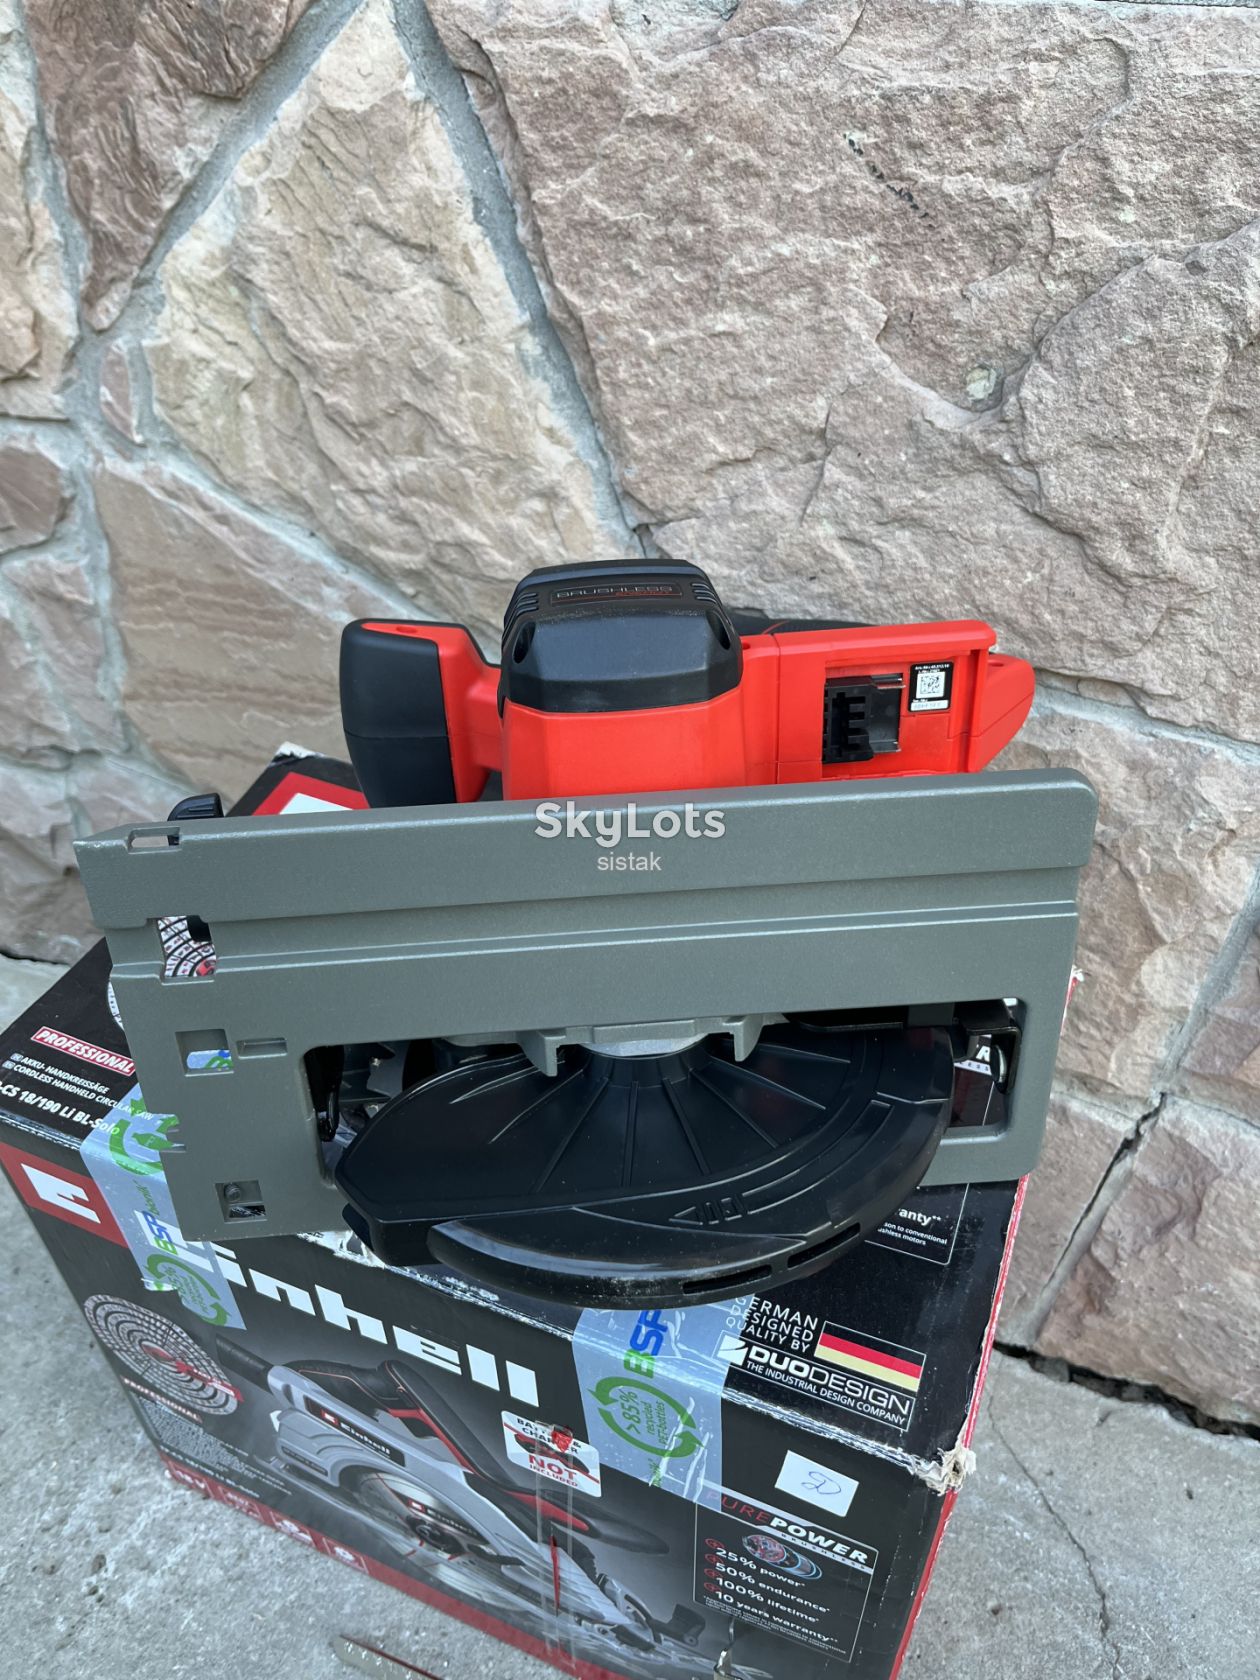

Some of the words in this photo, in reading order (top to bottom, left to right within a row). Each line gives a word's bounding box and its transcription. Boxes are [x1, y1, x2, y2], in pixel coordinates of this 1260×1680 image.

[36, 1030, 135, 1073] PROFESSIONAL
[13, 1064, 54, 1083] CORDLESS
[51, 1079, 96, 1100] HANDHELD
[21, 1056, 46, 1070] AKKU-
[45, 1066, 110, 1094] HANDKREISSÄGE
[20, 1090, 62, 1114] 18/190
[61, 1104, 76, 1119] Li
[73, 1110, 120, 1135] BL-Solo
[898, 1208, 941, 1226] anty
[902, 1234, 926, 1246] motors
[905, 1227, 948, 1245] conventional
[730, 1305, 814, 1342] DESIGNED
[735, 1296, 818, 1330] GERMAN
[726, 1316, 787, 1346] QUALITY
[791, 1339, 811, 1353] BY
[747, 1360, 764, 1374] THE
[765, 1365, 818, 1394] INDUSTRIAL
[819, 1386, 855, 1408] DESIGN
[856, 1401, 906, 1426] COMPANY
[529, 1454, 577, 1481] NOT
[529, 1464, 578, 1487] INCLUDED
[715, 1547, 757, 1570] 25%
[715, 1562, 756, 1584] 50%
[716, 1577, 764, 1602] 100%
[716, 1591, 734, 1604] 10
[736, 1600, 770, 1619] years
